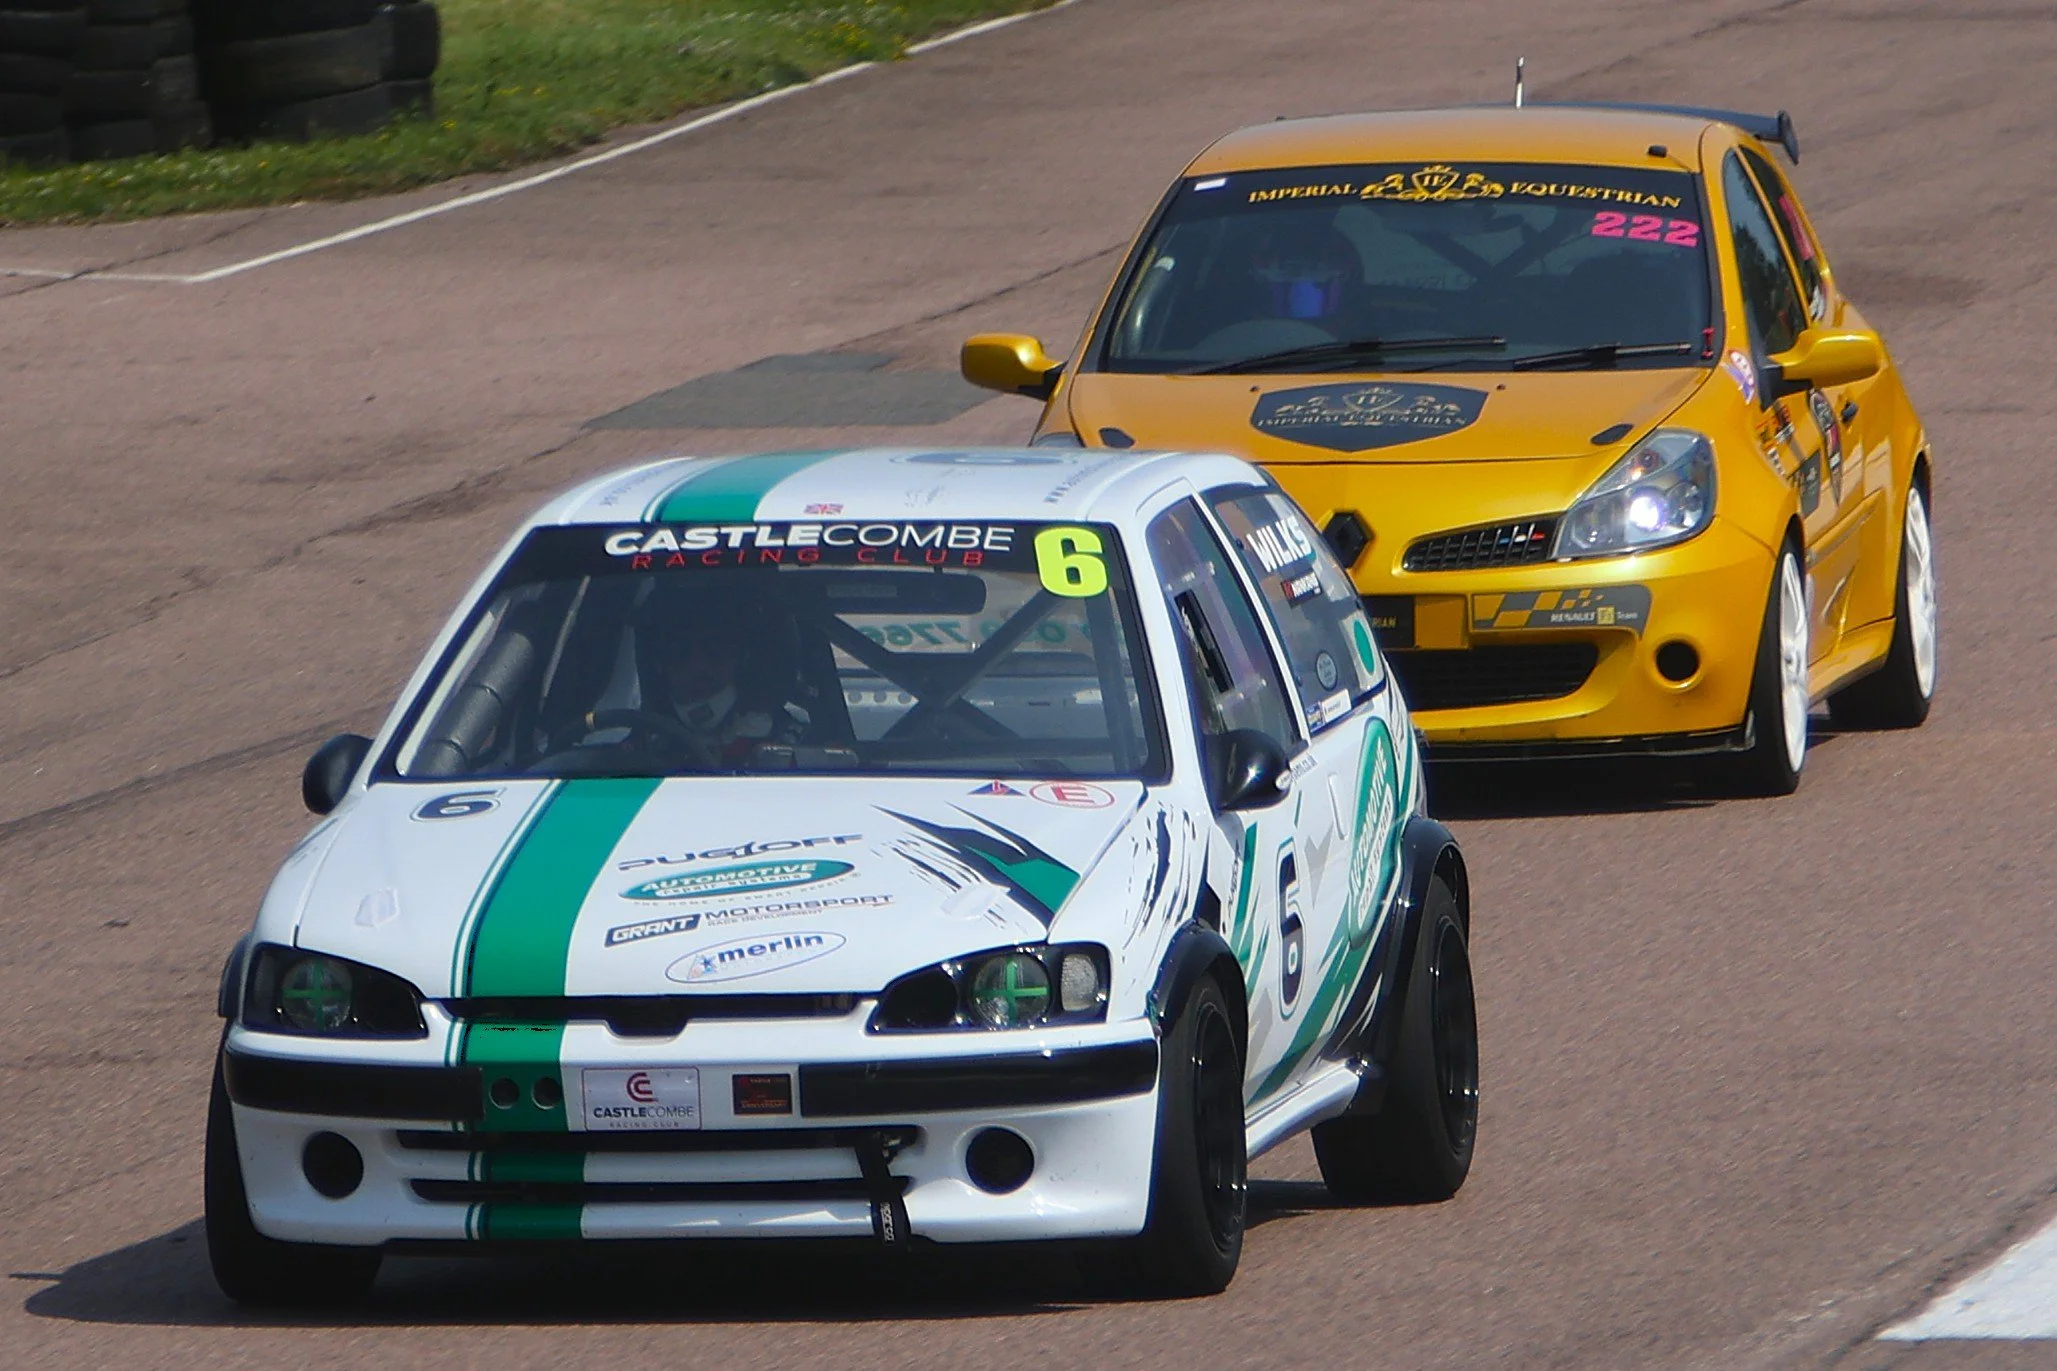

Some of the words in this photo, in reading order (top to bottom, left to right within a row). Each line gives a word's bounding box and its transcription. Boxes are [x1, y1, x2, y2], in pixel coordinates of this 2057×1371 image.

[1248, 183, 1359, 203] IMPERIAL
[1510, 182, 1682, 209] EQUESTRIAN
[1591, 211, 1700, 248] 222
[604, 524, 1015, 556] CASTLECOMBE
[1246, 515, 1312, 573] WILKS
[631, 547, 820, 570] RACING
[858, 547, 986, 567] CLUB
[1034, 527, 1108, 598] 6
[417, 789, 498, 819] 6
[1050, 786, 1096, 804] E
[641, 862, 818, 893] AUTOMOTIVE
[611, 915, 697, 943] GRANT
[704, 894, 894, 921] MOTORSPORT
[1279, 851, 1304, 1006] 6
[717, 933, 824, 964] merlin
[593, 1106, 695, 1120] CASTLECOMBE
